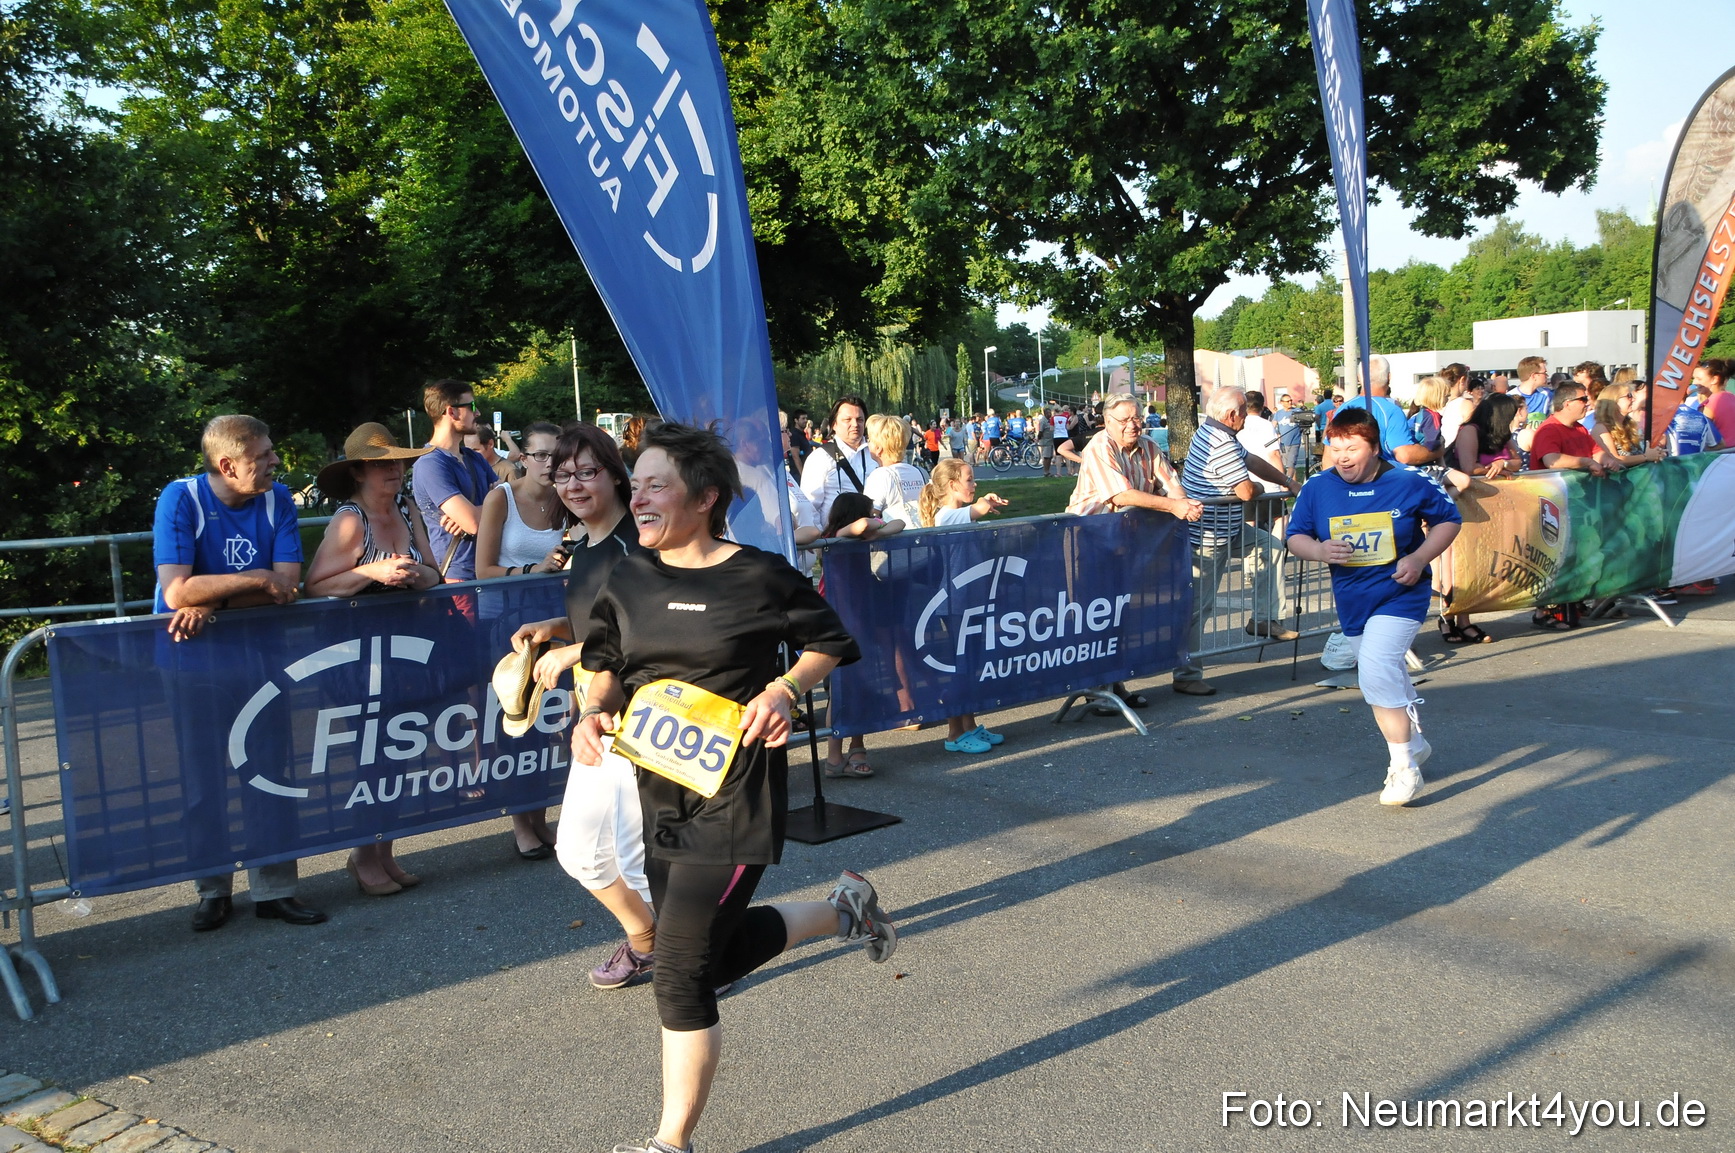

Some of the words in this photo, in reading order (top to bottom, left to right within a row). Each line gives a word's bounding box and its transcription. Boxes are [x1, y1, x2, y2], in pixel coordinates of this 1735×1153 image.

[1348, 489, 1375, 497] hummel
[956, 590, 1131, 656] Fischer
[979, 636, 1119, 682] AUTOMOBILE
[311, 682, 575, 775] Fische
[631, 706, 732, 772] 1095
[344, 745, 568, 810] AUTOMOBIL
